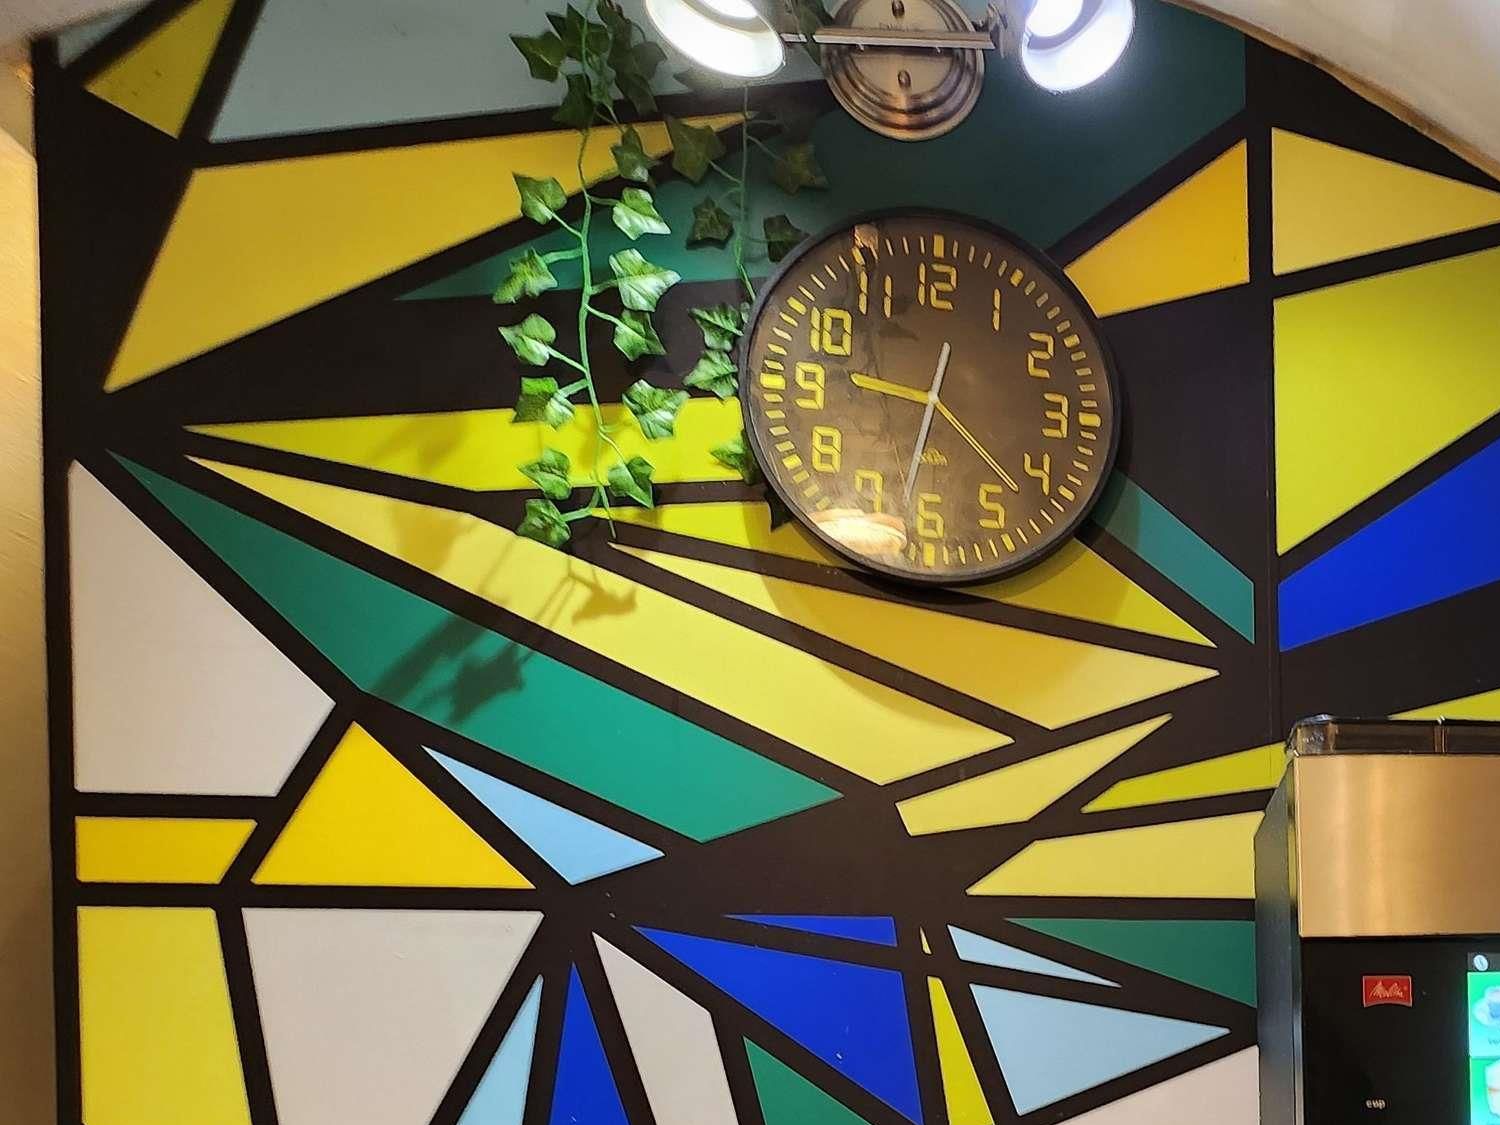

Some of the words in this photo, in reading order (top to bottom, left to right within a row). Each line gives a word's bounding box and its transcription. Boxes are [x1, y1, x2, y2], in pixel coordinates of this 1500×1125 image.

[858, 271, 892, 318] 11
[918, 263, 957, 310] 12
[992, 288, 1001, 331] 1
[810, 306, 852, 356] 10
[1028, 332, 1054, 378] 2
[795, 361, 825, 410] 9
[1042, 392, 1068, 438] 3
[812, 425, 842, 473] 8
[854, 469, 883, 513] 7
[1024, 453, 1050, 495] 4
[917, 493, 944, 538] 6
[979, 484, 1005, 529] 5
